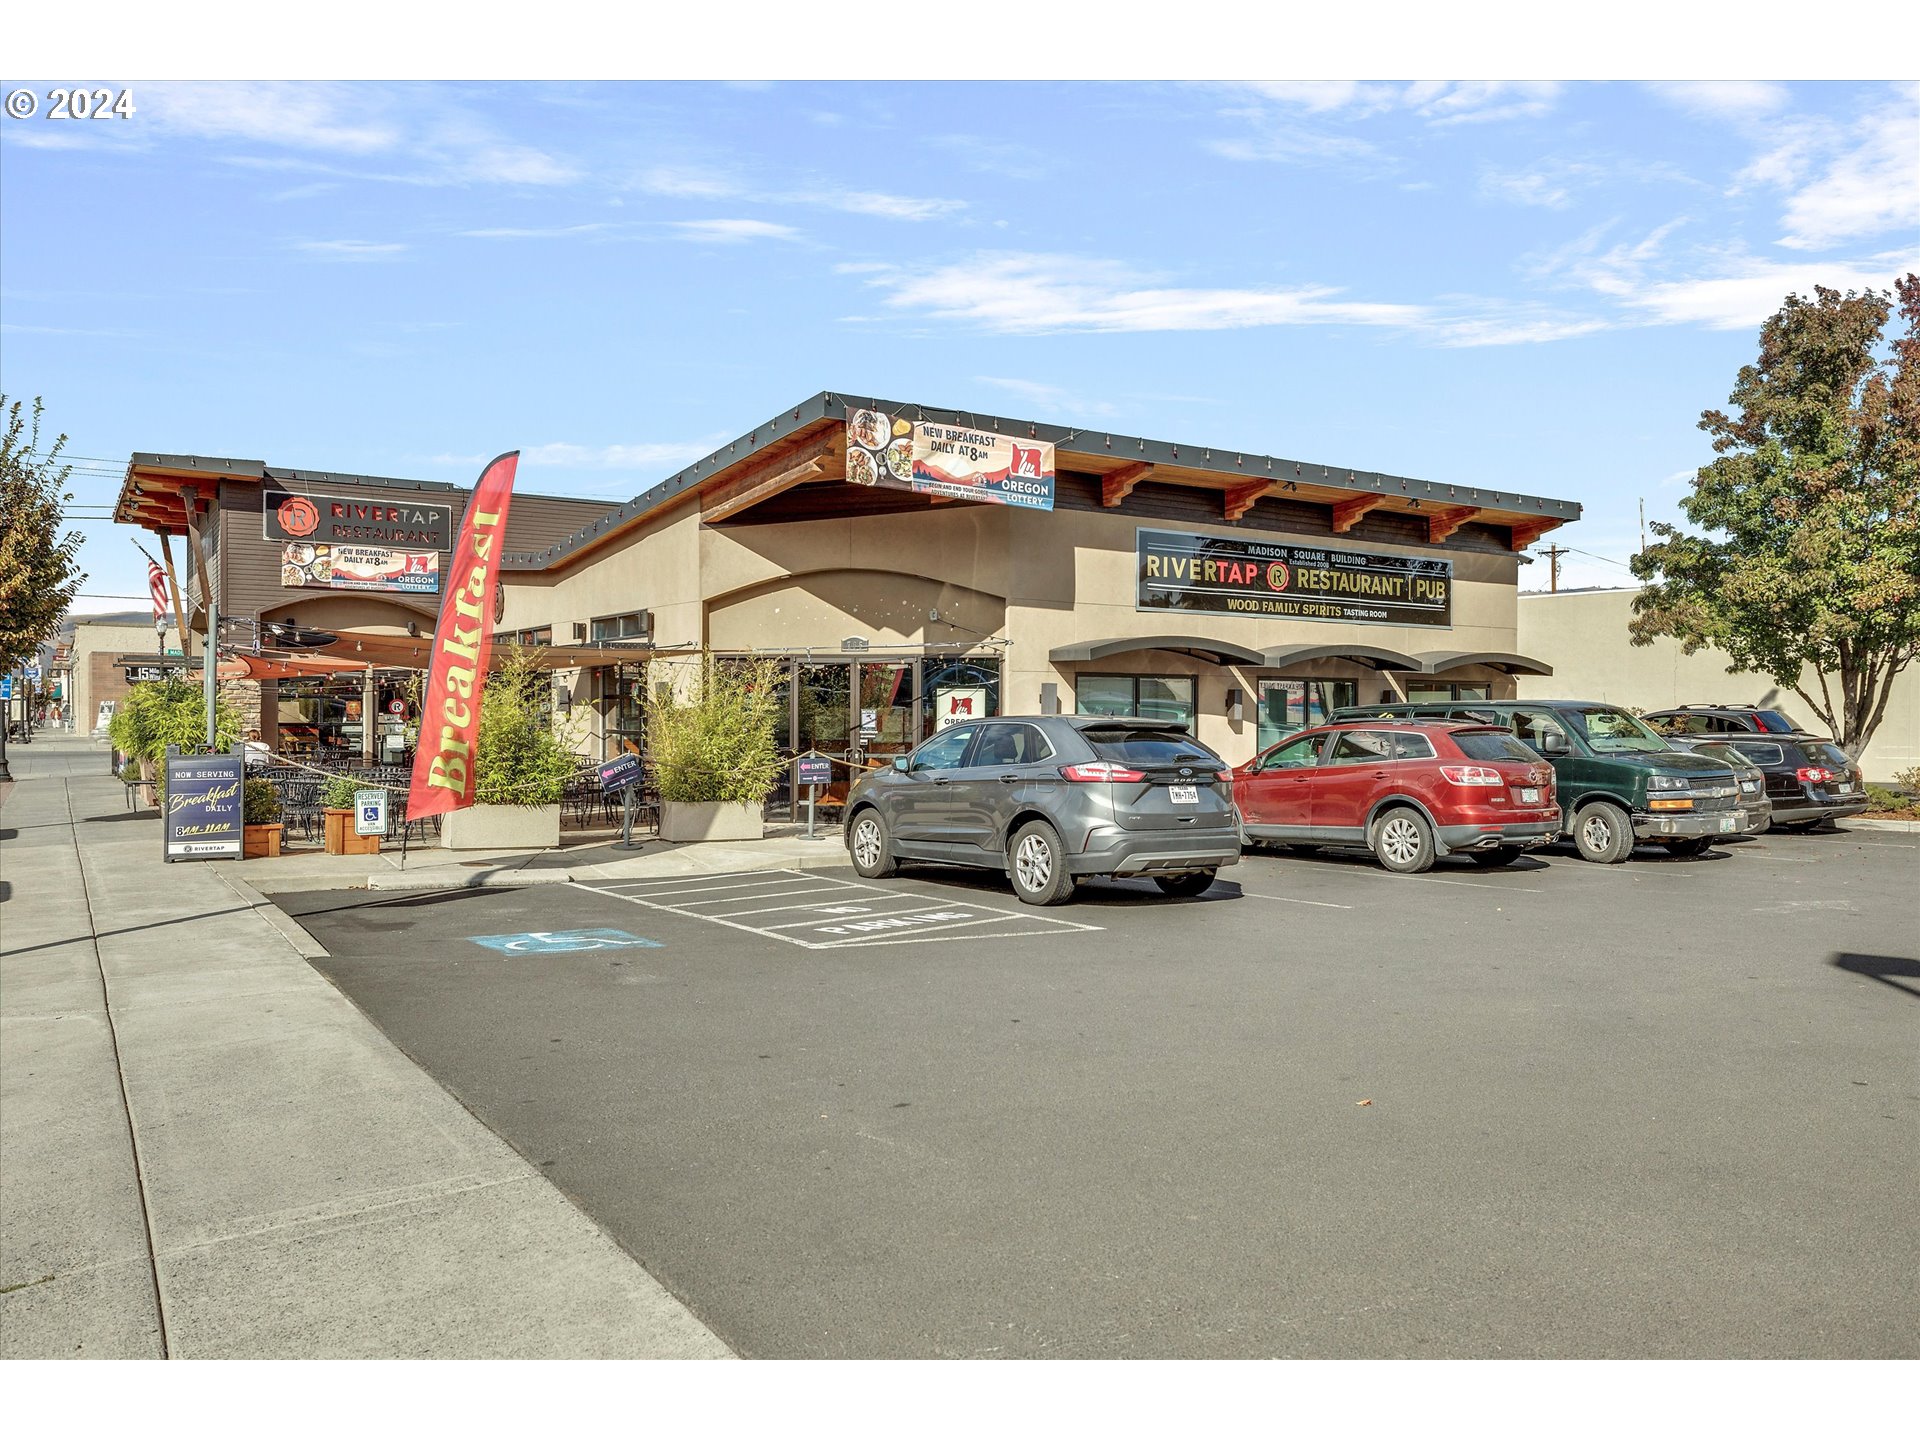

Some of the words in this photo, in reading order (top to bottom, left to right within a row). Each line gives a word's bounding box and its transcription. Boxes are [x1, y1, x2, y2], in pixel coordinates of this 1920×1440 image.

[923, 425, 942, 439] NEW
[945, 429, 996, 447] BREAKFAST
[931, 440, 955, 454] DAILY
[1002, 479, 1049, 496] OREGON
[331, 502, 440, 525] RIVERTAP
[332, 524, 440, 543] RESTAURANT
[338, 548, 353, 556] NEW
[355, 549, 393, 558] BREAKFAST
[344, 556, 364, 564] DAILY
[1248, 545, 1287, 558] MADISON
[1294, 550, 1325, 561] SQUARE
[1331, 554, 1367, 566] BUILDING
[1289, 559, 1316, 567] Established
[398, 576, 434, 584] OREGON
[1147, 555, 1258, 585] RIVERTAP
[1297, 568, 1403, 596] RESTAURANT
[1416, 579, 1446, 599] PUB
[1227, 598, 1259, 611] WOOD
[1262, 601, 1300, 614] FAMILY
[1302, 604, 1342, 617] SPIRITS
[1343, 608, 1369, 618] TASTING
[1369, 611, 1387, 619] ROOM
[428, 505, 502, 799] Breakfast
[138, 667, 149, 680] 15
[613, 760, 637, 774] ENTER
[168, 781, 240, 814] Breakfast
[814, 912, 974, 935] PARKING
